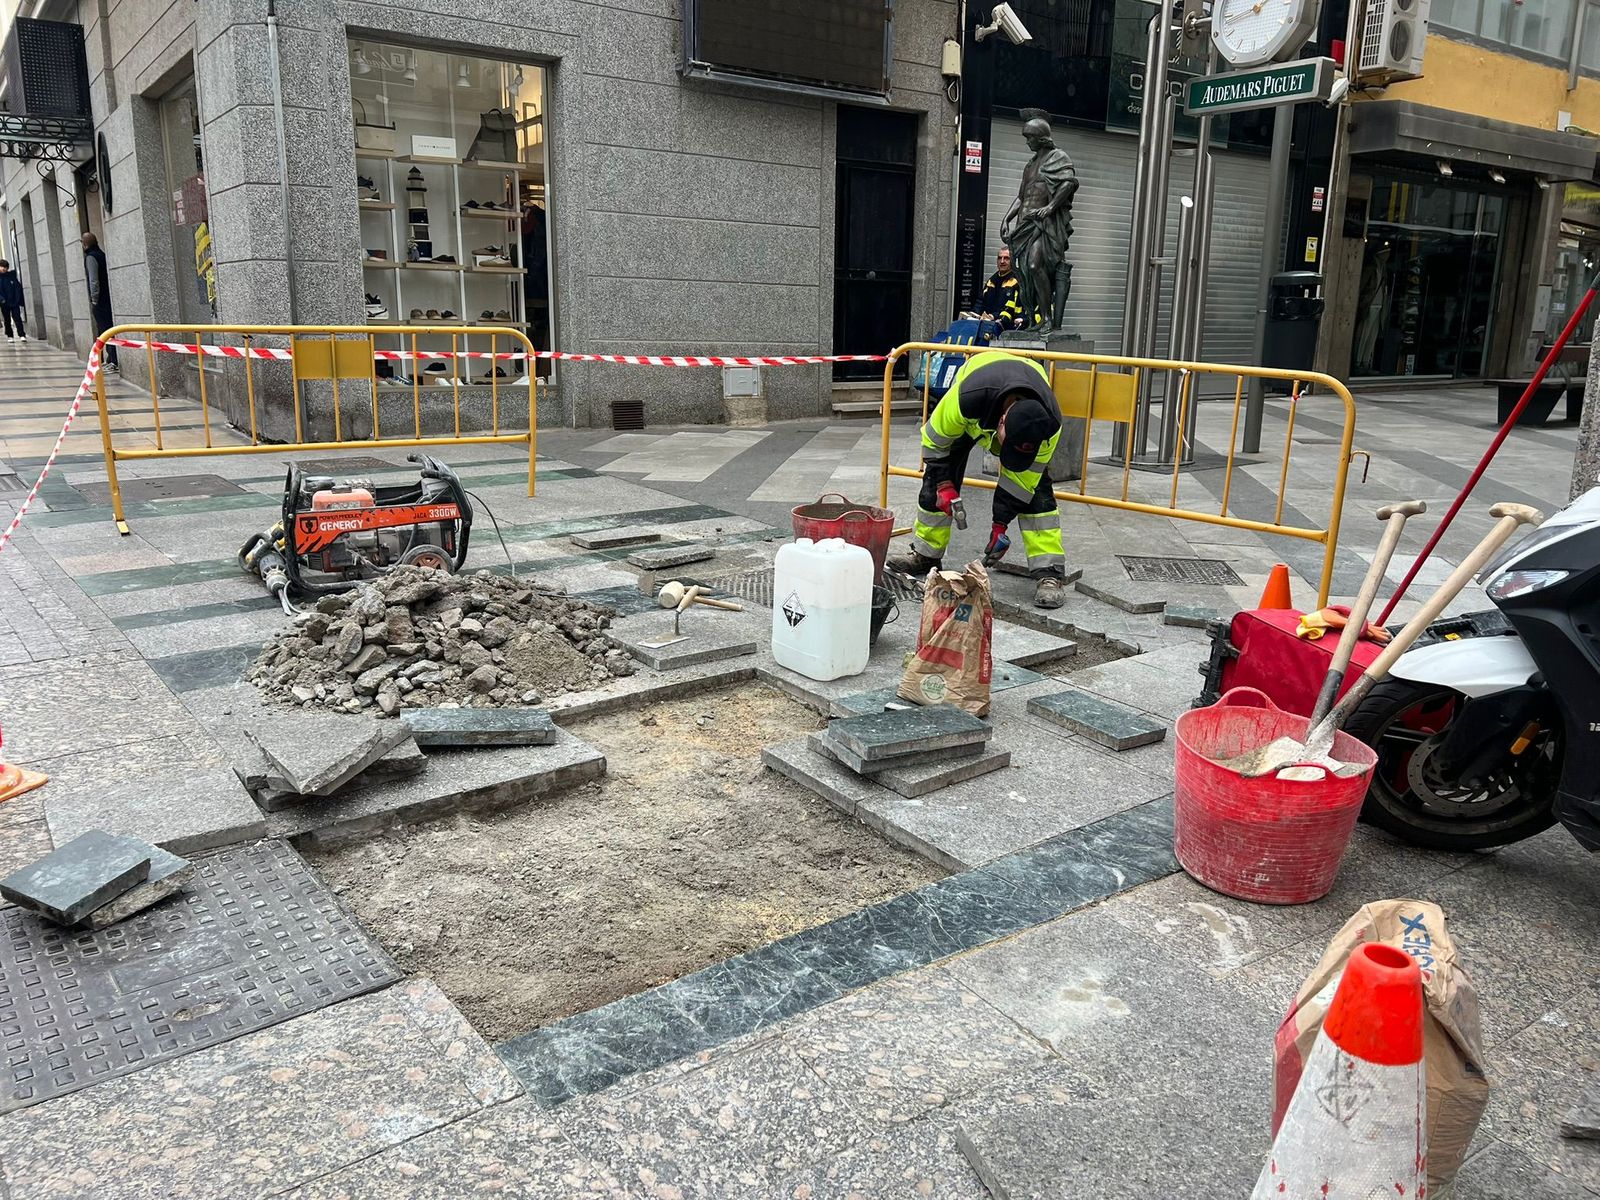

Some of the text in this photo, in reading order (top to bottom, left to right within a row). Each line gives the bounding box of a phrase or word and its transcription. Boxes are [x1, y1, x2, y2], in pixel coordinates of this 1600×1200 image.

[1200, 81, 1261, 105] AUDEMARS
[1262, 73, 1305, 96] PIGUET
[319, 519, 364, 532] GENERGY
